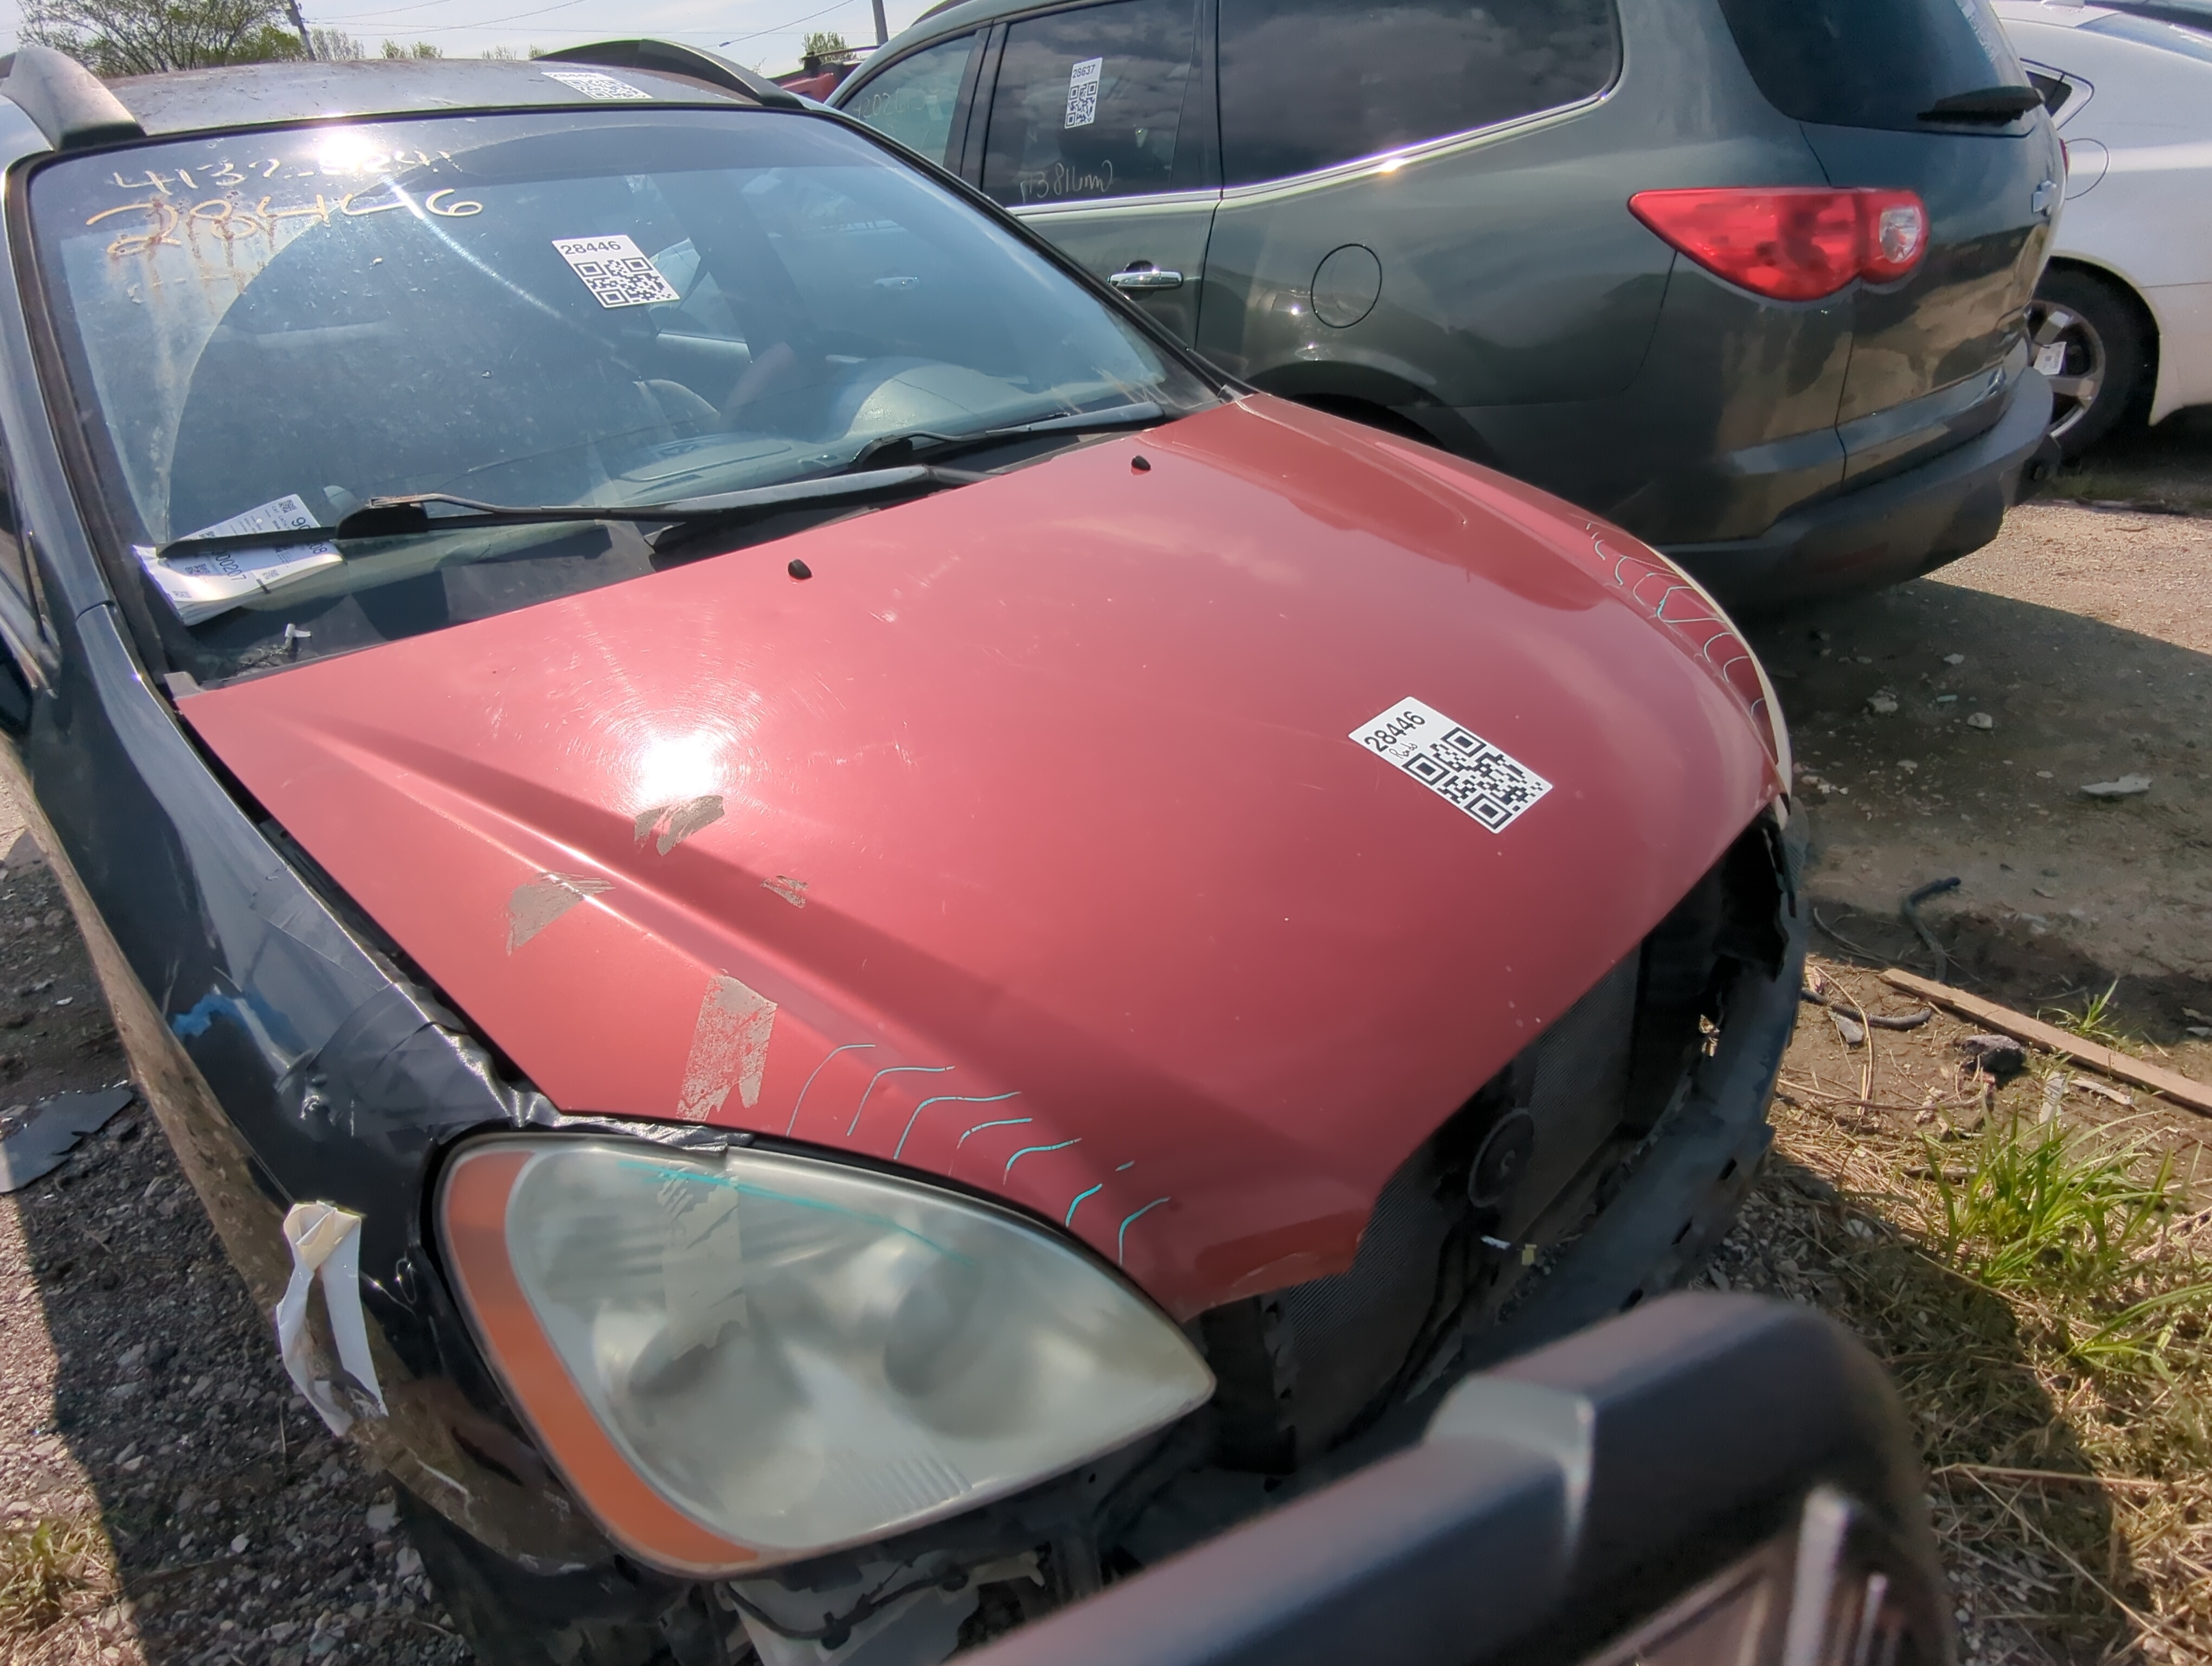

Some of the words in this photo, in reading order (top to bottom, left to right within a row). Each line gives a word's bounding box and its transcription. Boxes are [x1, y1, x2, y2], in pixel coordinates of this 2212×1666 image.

[1072, 64, 1096, 79] 28637
[86, 187, 484, 257] 28446
[560, 241, 621, 255] 28446
[1364, 711, 1425, 753] 28446
